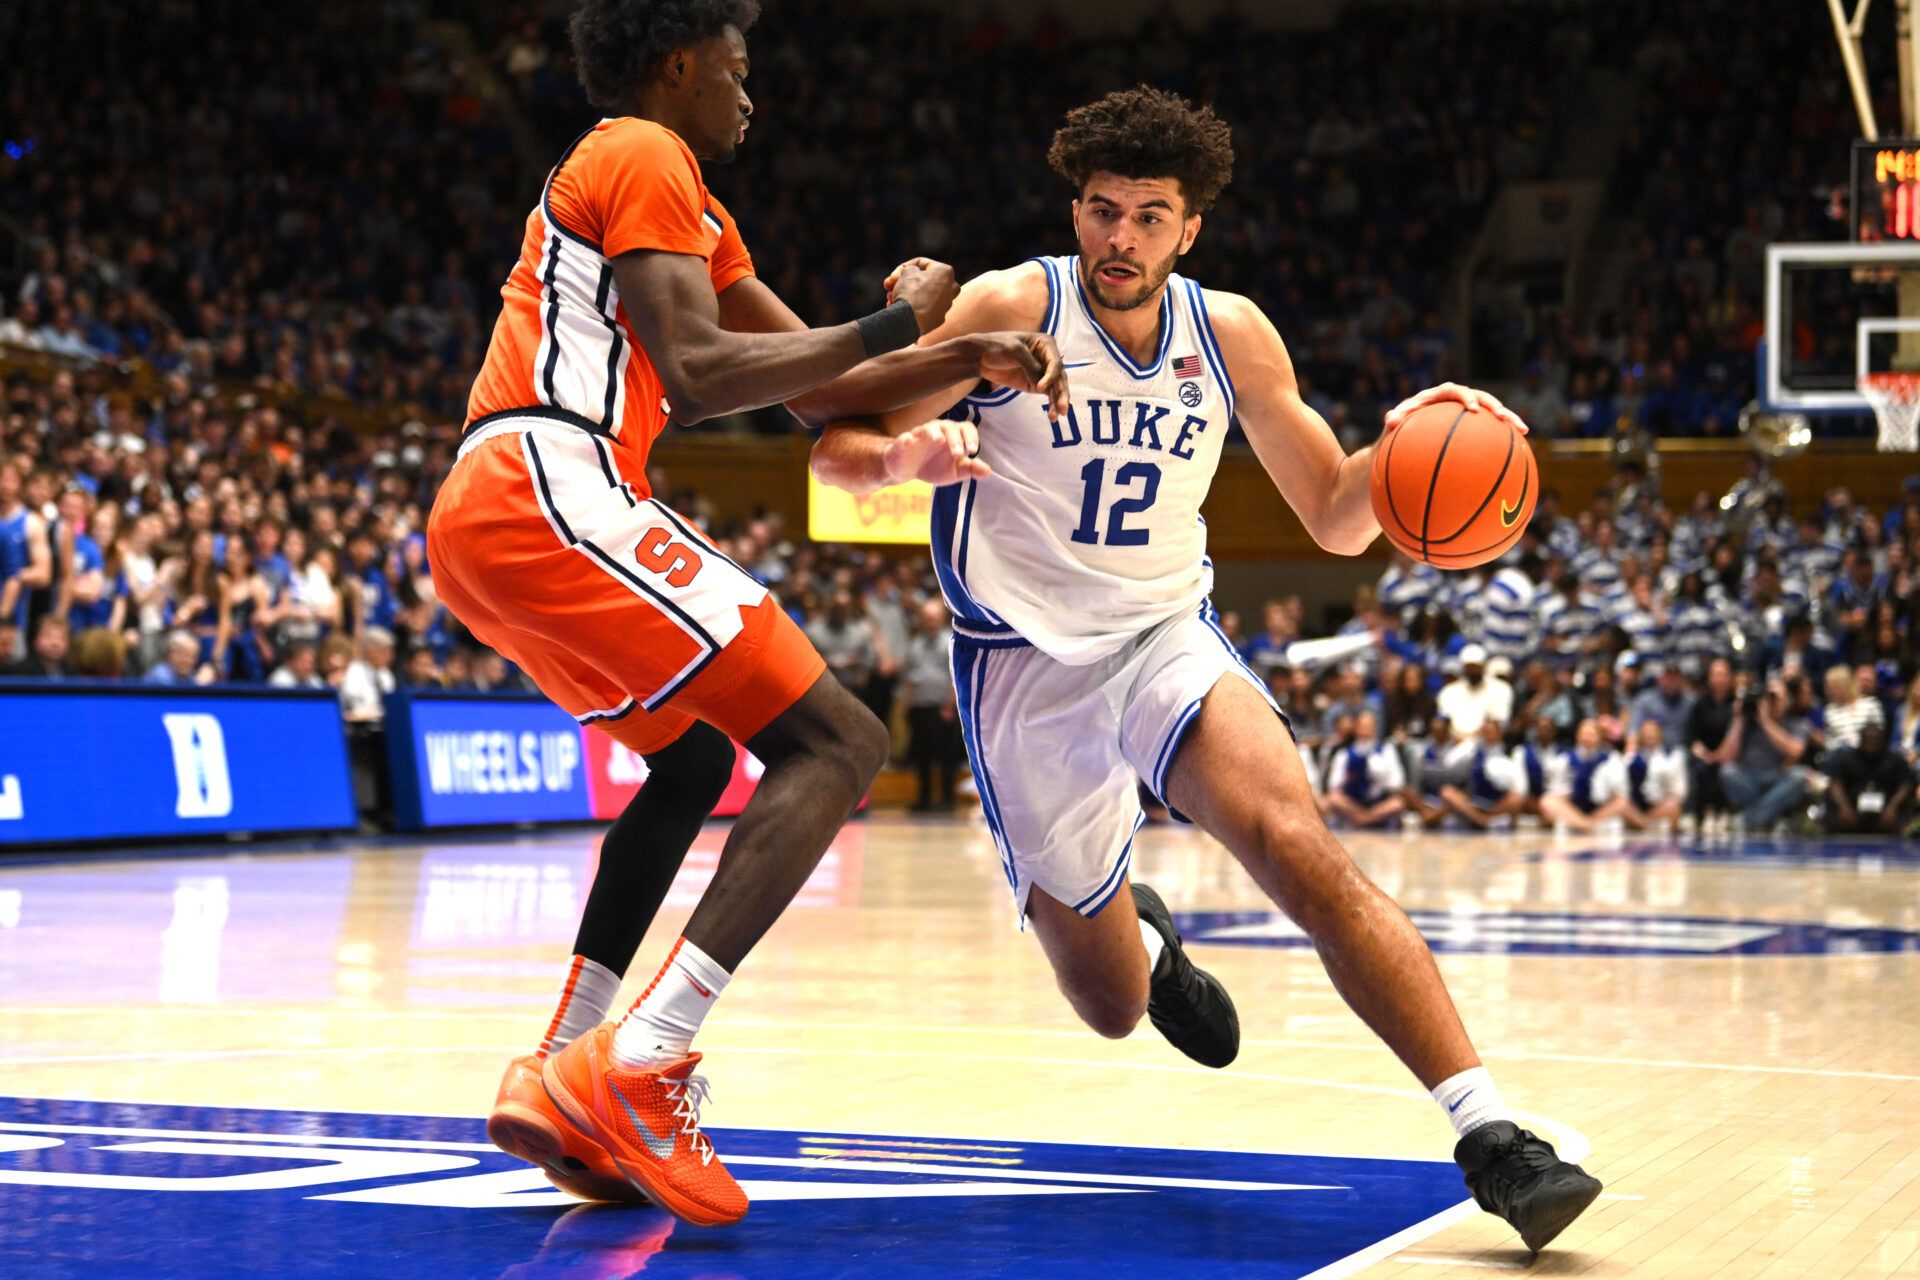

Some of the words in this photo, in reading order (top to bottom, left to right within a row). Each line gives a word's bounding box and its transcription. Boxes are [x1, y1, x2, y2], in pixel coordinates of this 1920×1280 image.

[1042, 399, 1208, 461] DUKE
[1071, 458, 1162, 546] 12
[635, 527, 703, 588] S
[162, 712, 233, 818] D
[425, 731, 541, 794] WHEELS
[540, 731, 580, 792] UP
